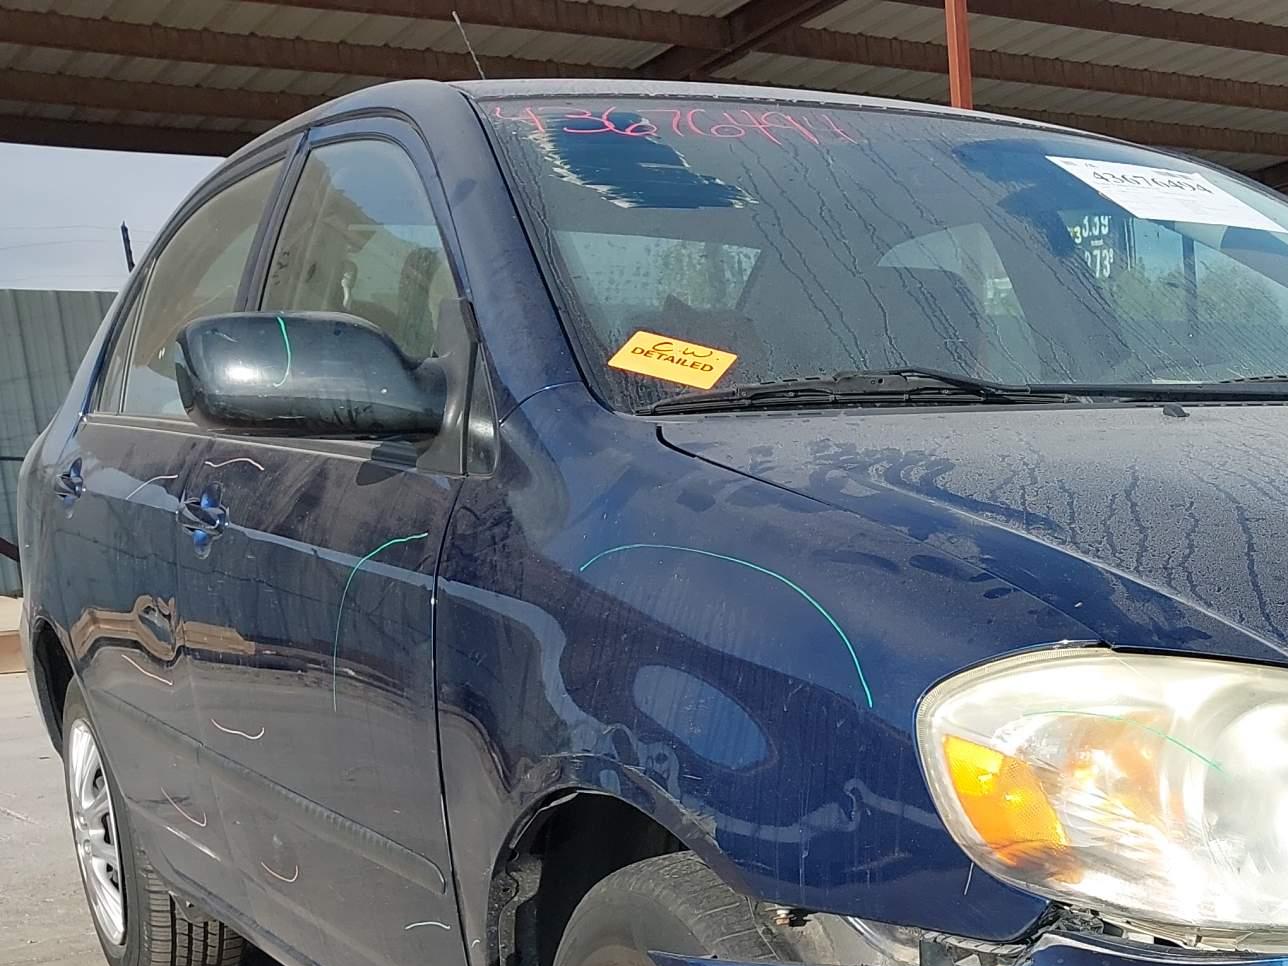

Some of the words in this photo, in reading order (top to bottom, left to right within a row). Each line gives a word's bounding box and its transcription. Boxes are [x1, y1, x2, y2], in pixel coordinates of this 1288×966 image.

[495, 105, 857, 145] 43676494
[1092, 171, 1213, 194] 43676494
[631, 346, 714, 372] DETAILED
